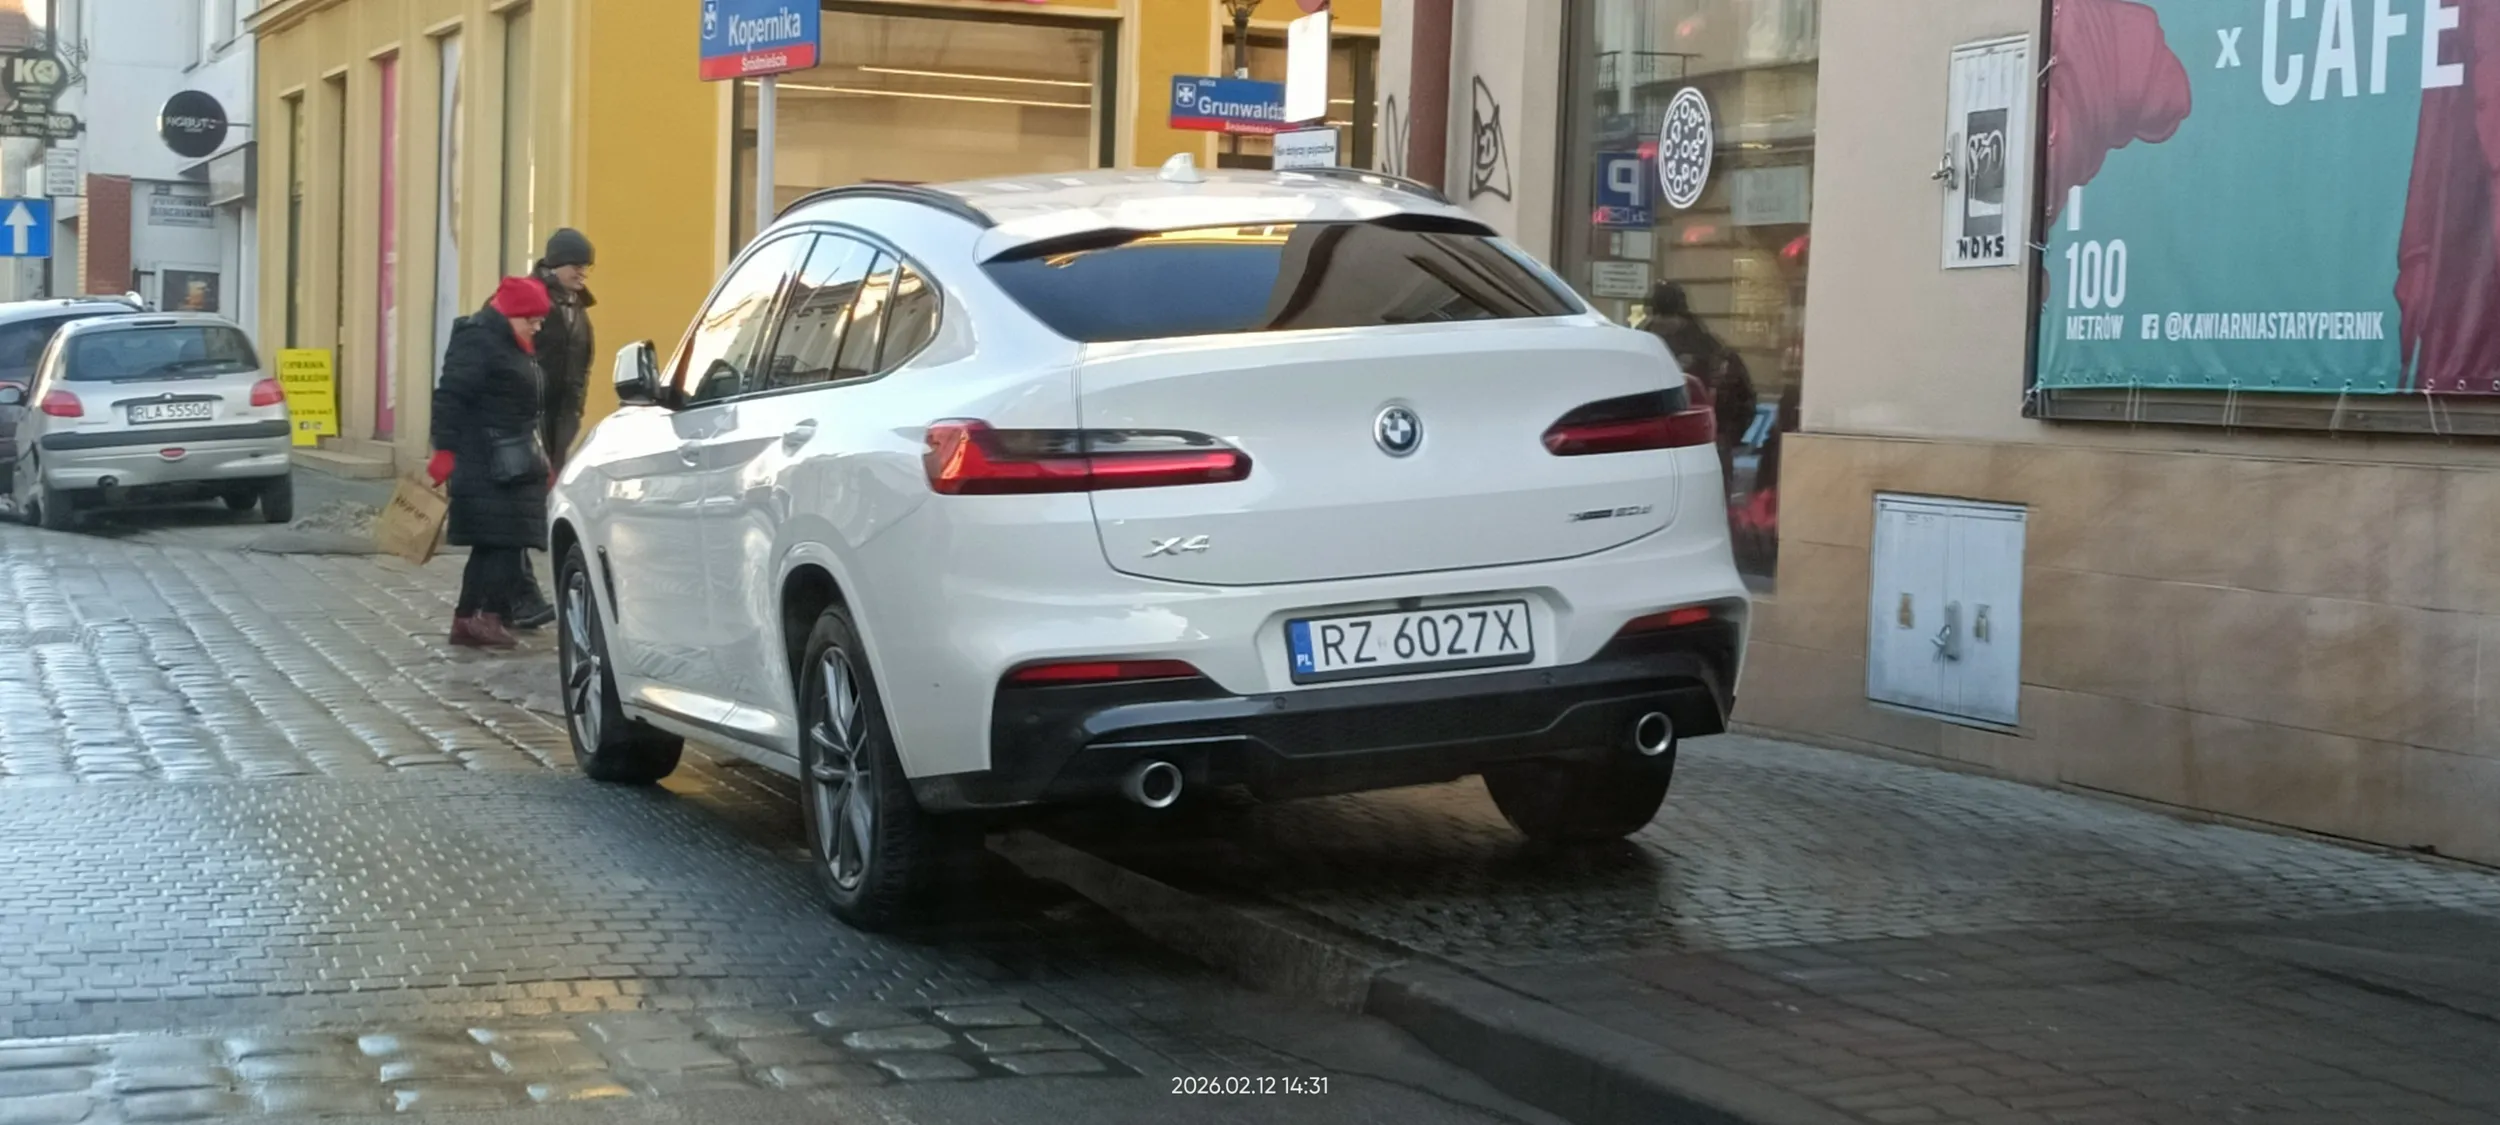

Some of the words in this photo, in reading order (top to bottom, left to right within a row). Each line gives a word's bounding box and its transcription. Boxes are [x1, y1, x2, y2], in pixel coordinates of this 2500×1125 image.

[728, 6, 801, 52] Kopernika
[741, 51, 788, 72] Śródmieście
[2262, 0, 2464, 106] CAFE
[1199, 79, 1216, 87] ulica
[1957, 234, 2005, 260] NOKS
[2065, 239, 2127, 309] 100
[2066, 312, 2124, 340] METRÓW
[2164, 311, 2384, 342] @KAWIARNIASTARYPIERNIK
[135, 405, 161, 420] RLA
[167, 402, 210, 418] 55506
[1141, 535, 1210, 559] X4
[1320, 620, 1377, 666] RZ
[1393, 609, 1518, 660] 6027X
[1297, 654, 1312, 666] PL
